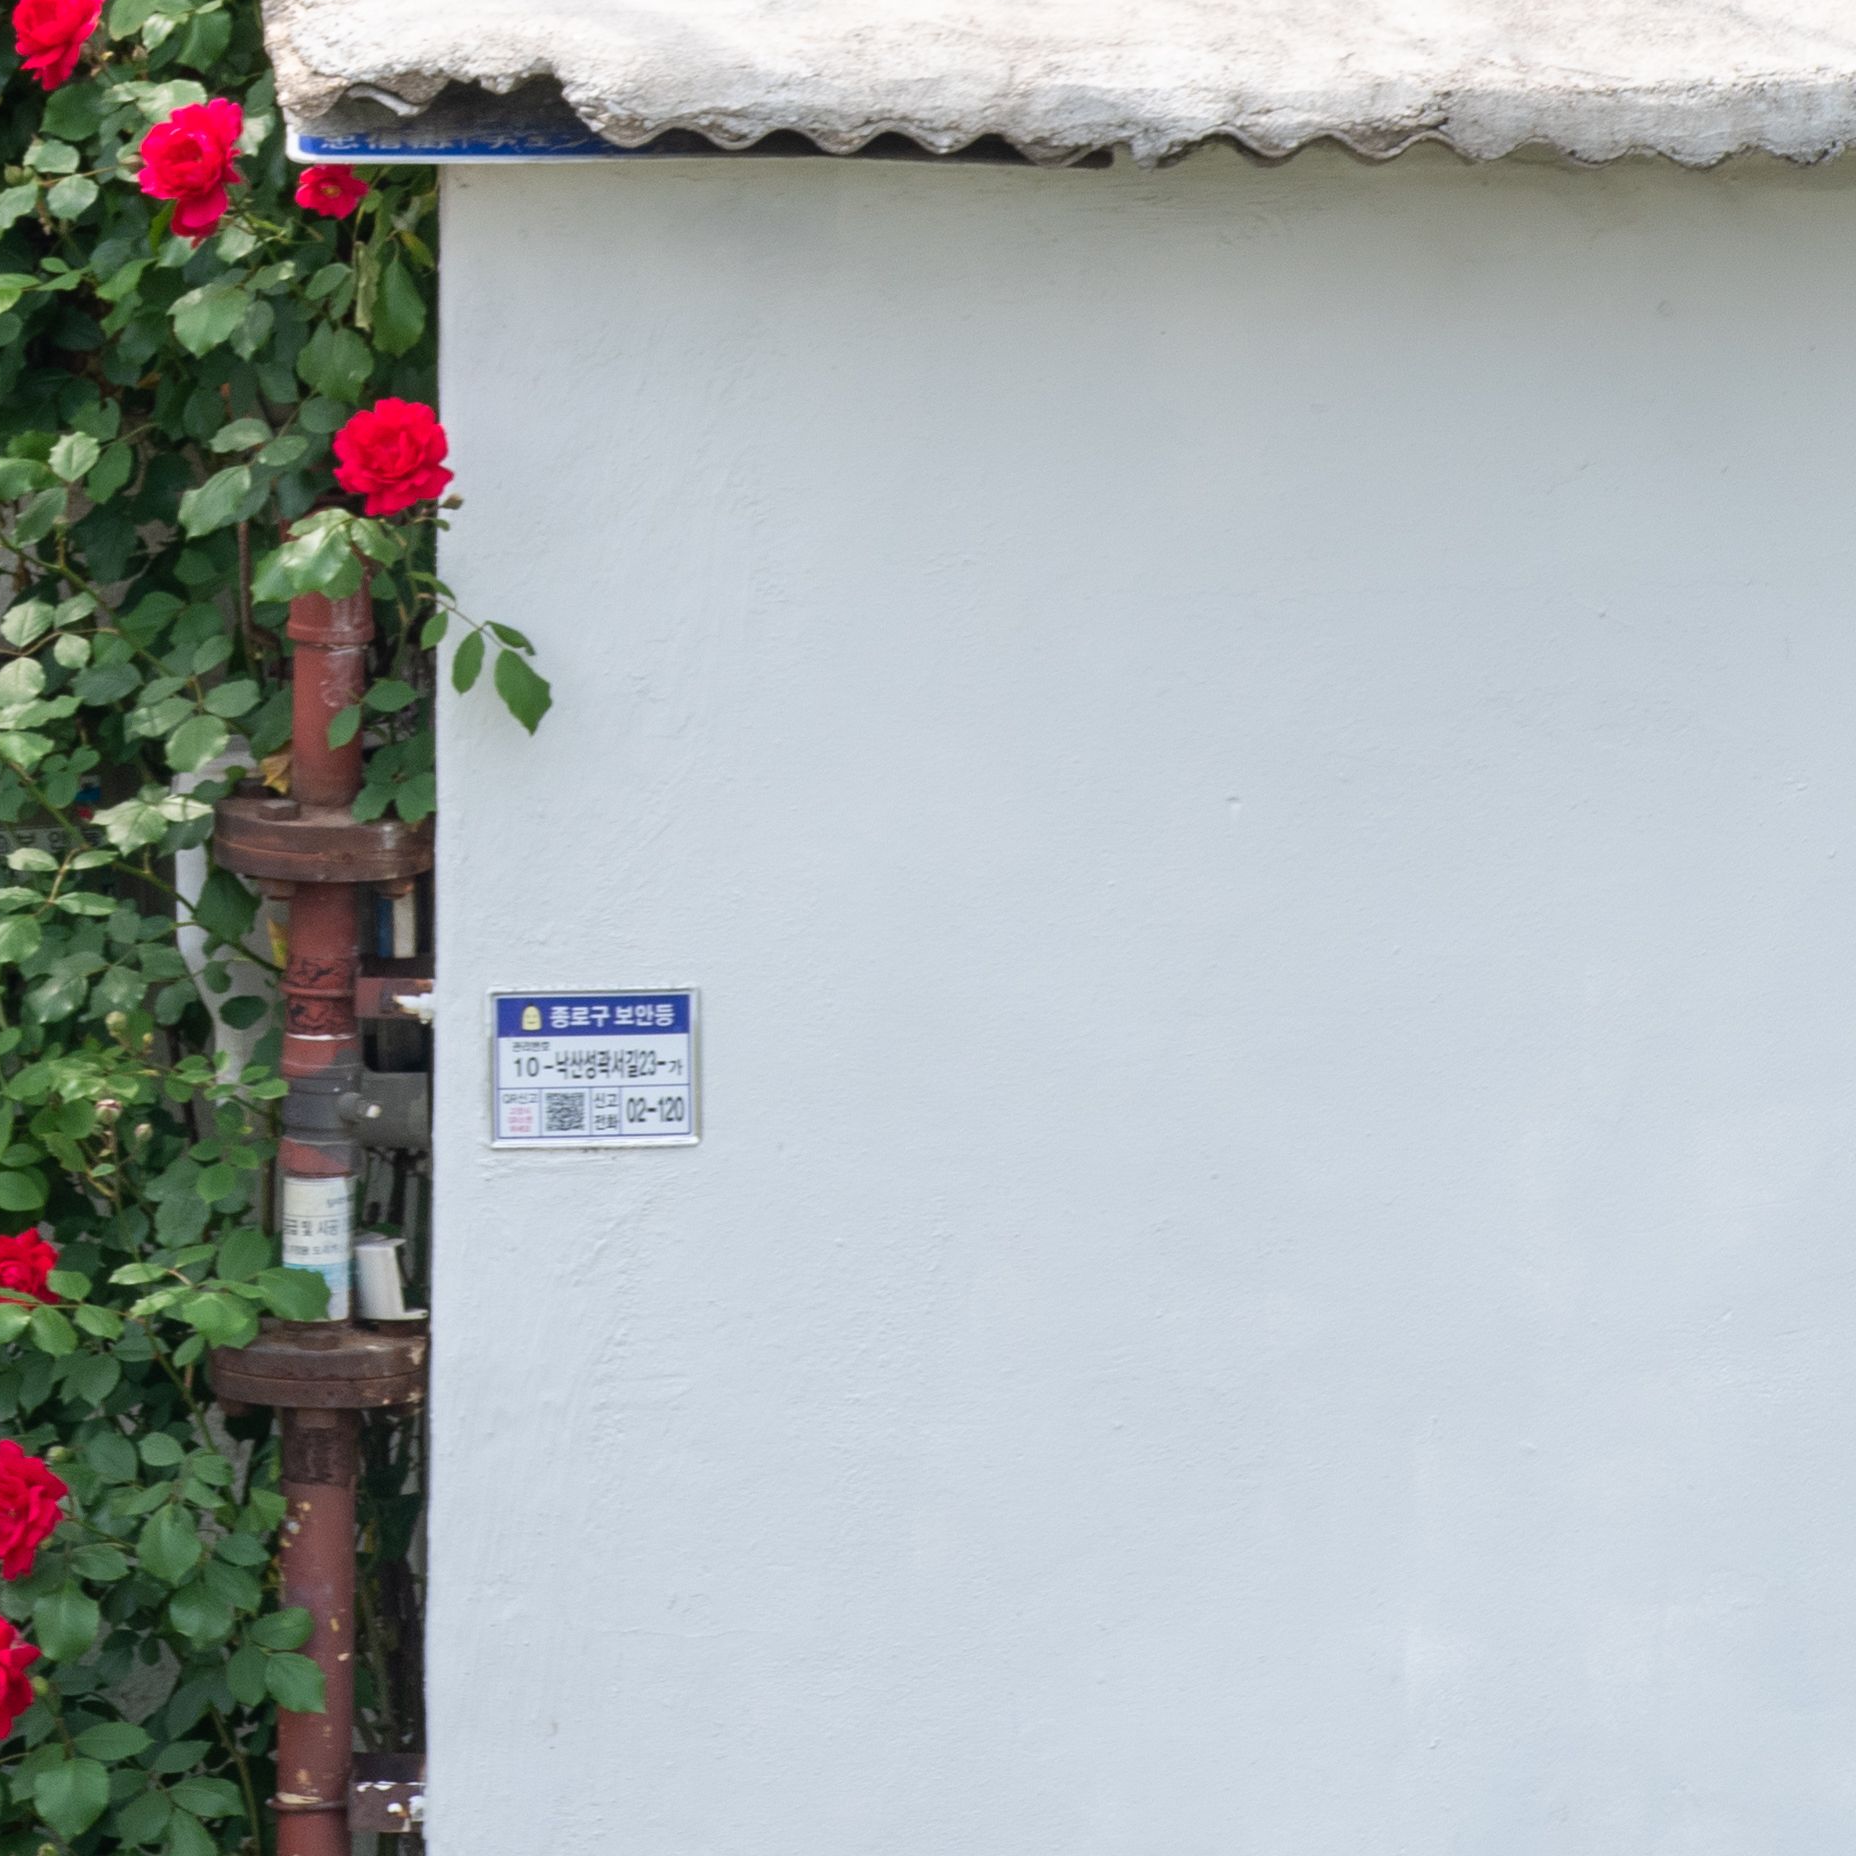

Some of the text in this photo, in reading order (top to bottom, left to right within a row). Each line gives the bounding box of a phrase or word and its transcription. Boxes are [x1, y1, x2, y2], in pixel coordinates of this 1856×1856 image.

[549, 1004, 675, 1028] 종로구 보안등
[593, 1092, 619, 1109] 신고
[626, 1096, 685, 1123] 02-120
[593, 1113, 620, 1131] 전화
